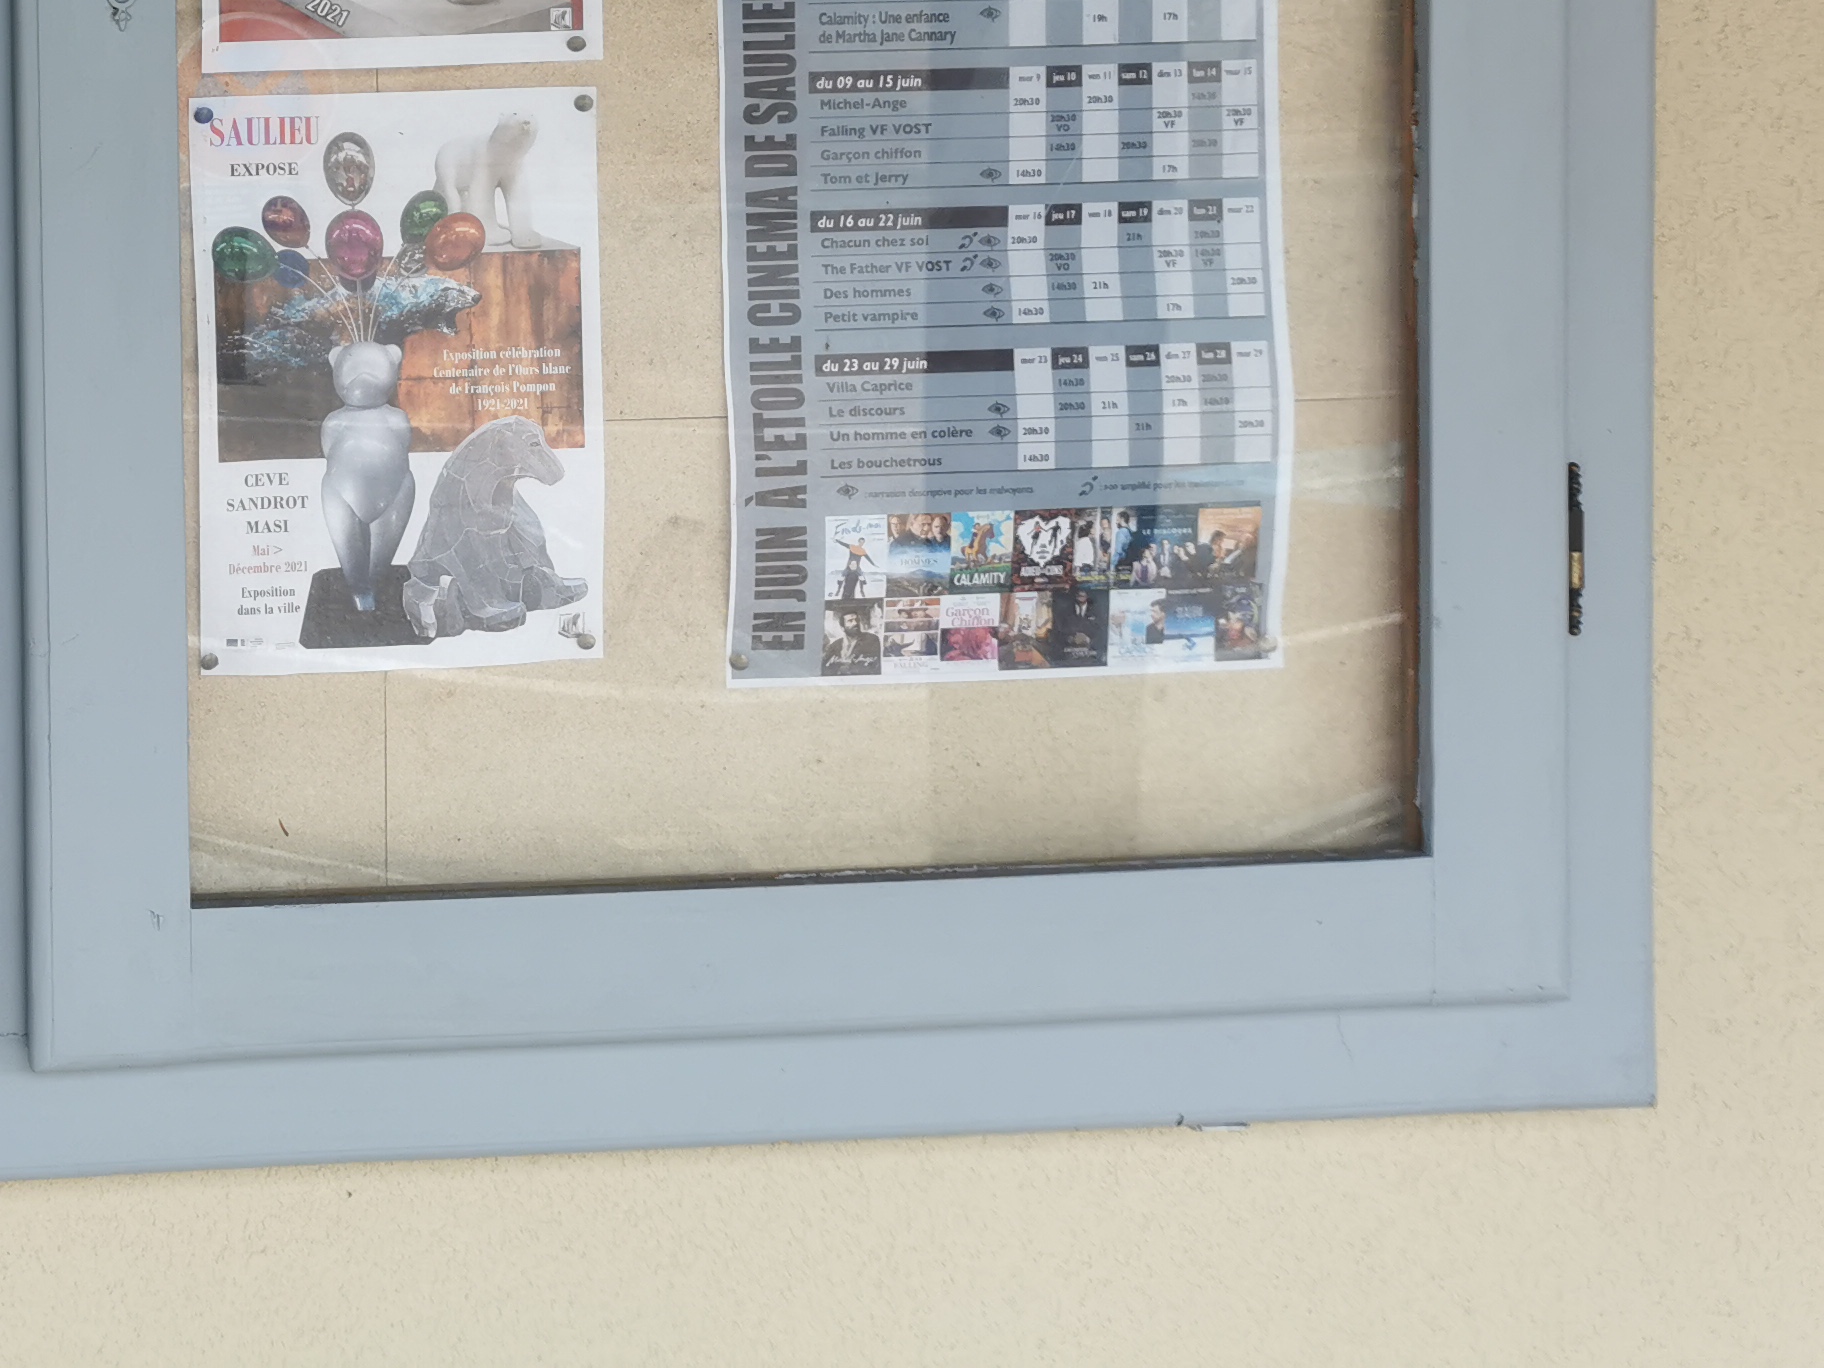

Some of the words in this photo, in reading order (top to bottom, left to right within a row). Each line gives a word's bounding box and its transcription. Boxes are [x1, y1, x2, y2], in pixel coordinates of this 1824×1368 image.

[820, 97, 908, 111] Michel-Ange
[209, 115, 320, 147] SAULIEU
[744, 133, 798, 178] DE
[820, 148, 870, 163] Garçon
[874, 147, 922, 159] chiffon
[229, 161, 299, 178] EXPOSE
[745, 185, 802, 327] CINEMA
[823, 288, 848, 300] Des
[852, 286, 912, 299] hommes
[749, 335, 808, 477] L'ETOILE
[830, 459, 852, 471] Les
[856, 456, 943, 469] bouchetrous
[244, 472, 290, 488] CEVE
[225, 495, 309, 512] SANDROT
[744, 484, 808, 509] À
[245, 519, 290, 535] MASI
[228, 561, 281, 576] Décembre
[284, 560, 309, 574] 2021
[751, 525, 809, 603] JUIN
[954, 571, 1006, 587] CALAMITY
[241, 585, 296, 601] Exposition
[237, 604, 261, 616] dans
[264, 604, 274, 615] la
[277, 602, 301, 615] ville
[751, 611, 805, 651] EN
